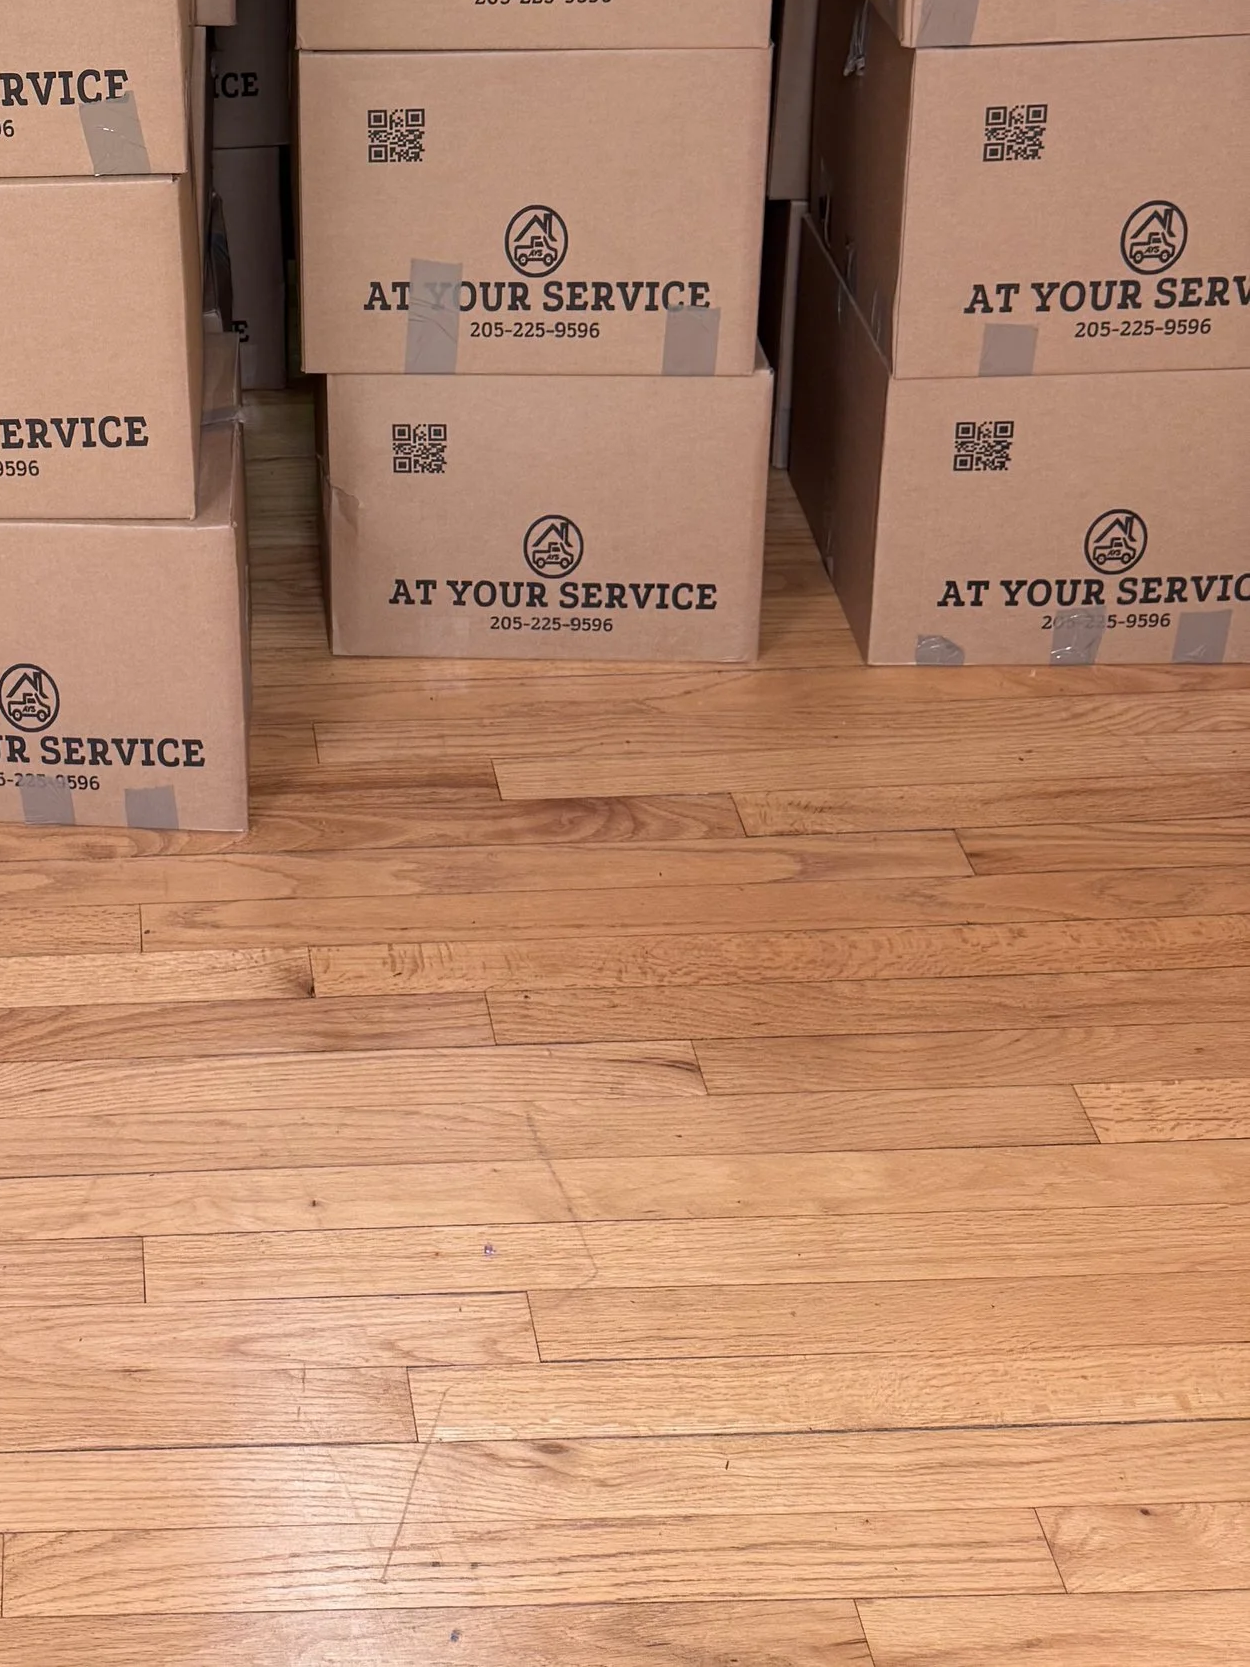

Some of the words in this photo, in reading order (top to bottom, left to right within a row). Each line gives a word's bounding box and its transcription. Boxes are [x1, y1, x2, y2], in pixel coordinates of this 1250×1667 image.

[528, 249, 543, 257] AYS
[1144, 245, 1159, 253] AYS
[364, 282, 411, 311] AT
[543, 281, 710, 312] SERVICE
[964, 283, 1020, 315] AT
[1031, 279, 1143, 312] YOUR
[470, 321, 600, 339] 205-225-9596
[1074, 318, 1212, 338] 205-225-9596
[389, 579, 437, 606] AT
[446, 580, 548, 608] YOUR
[559, 582, 717, 610] SERVICE
[937, 580, 990, 607] AT
[1000, 578, 1106, 606] YOUR
[1117, 573, 1250, 605] SERVIC
[490, 616, 614, 632] 205-225-9596
[41, 736, 206, 768] SERVICE
